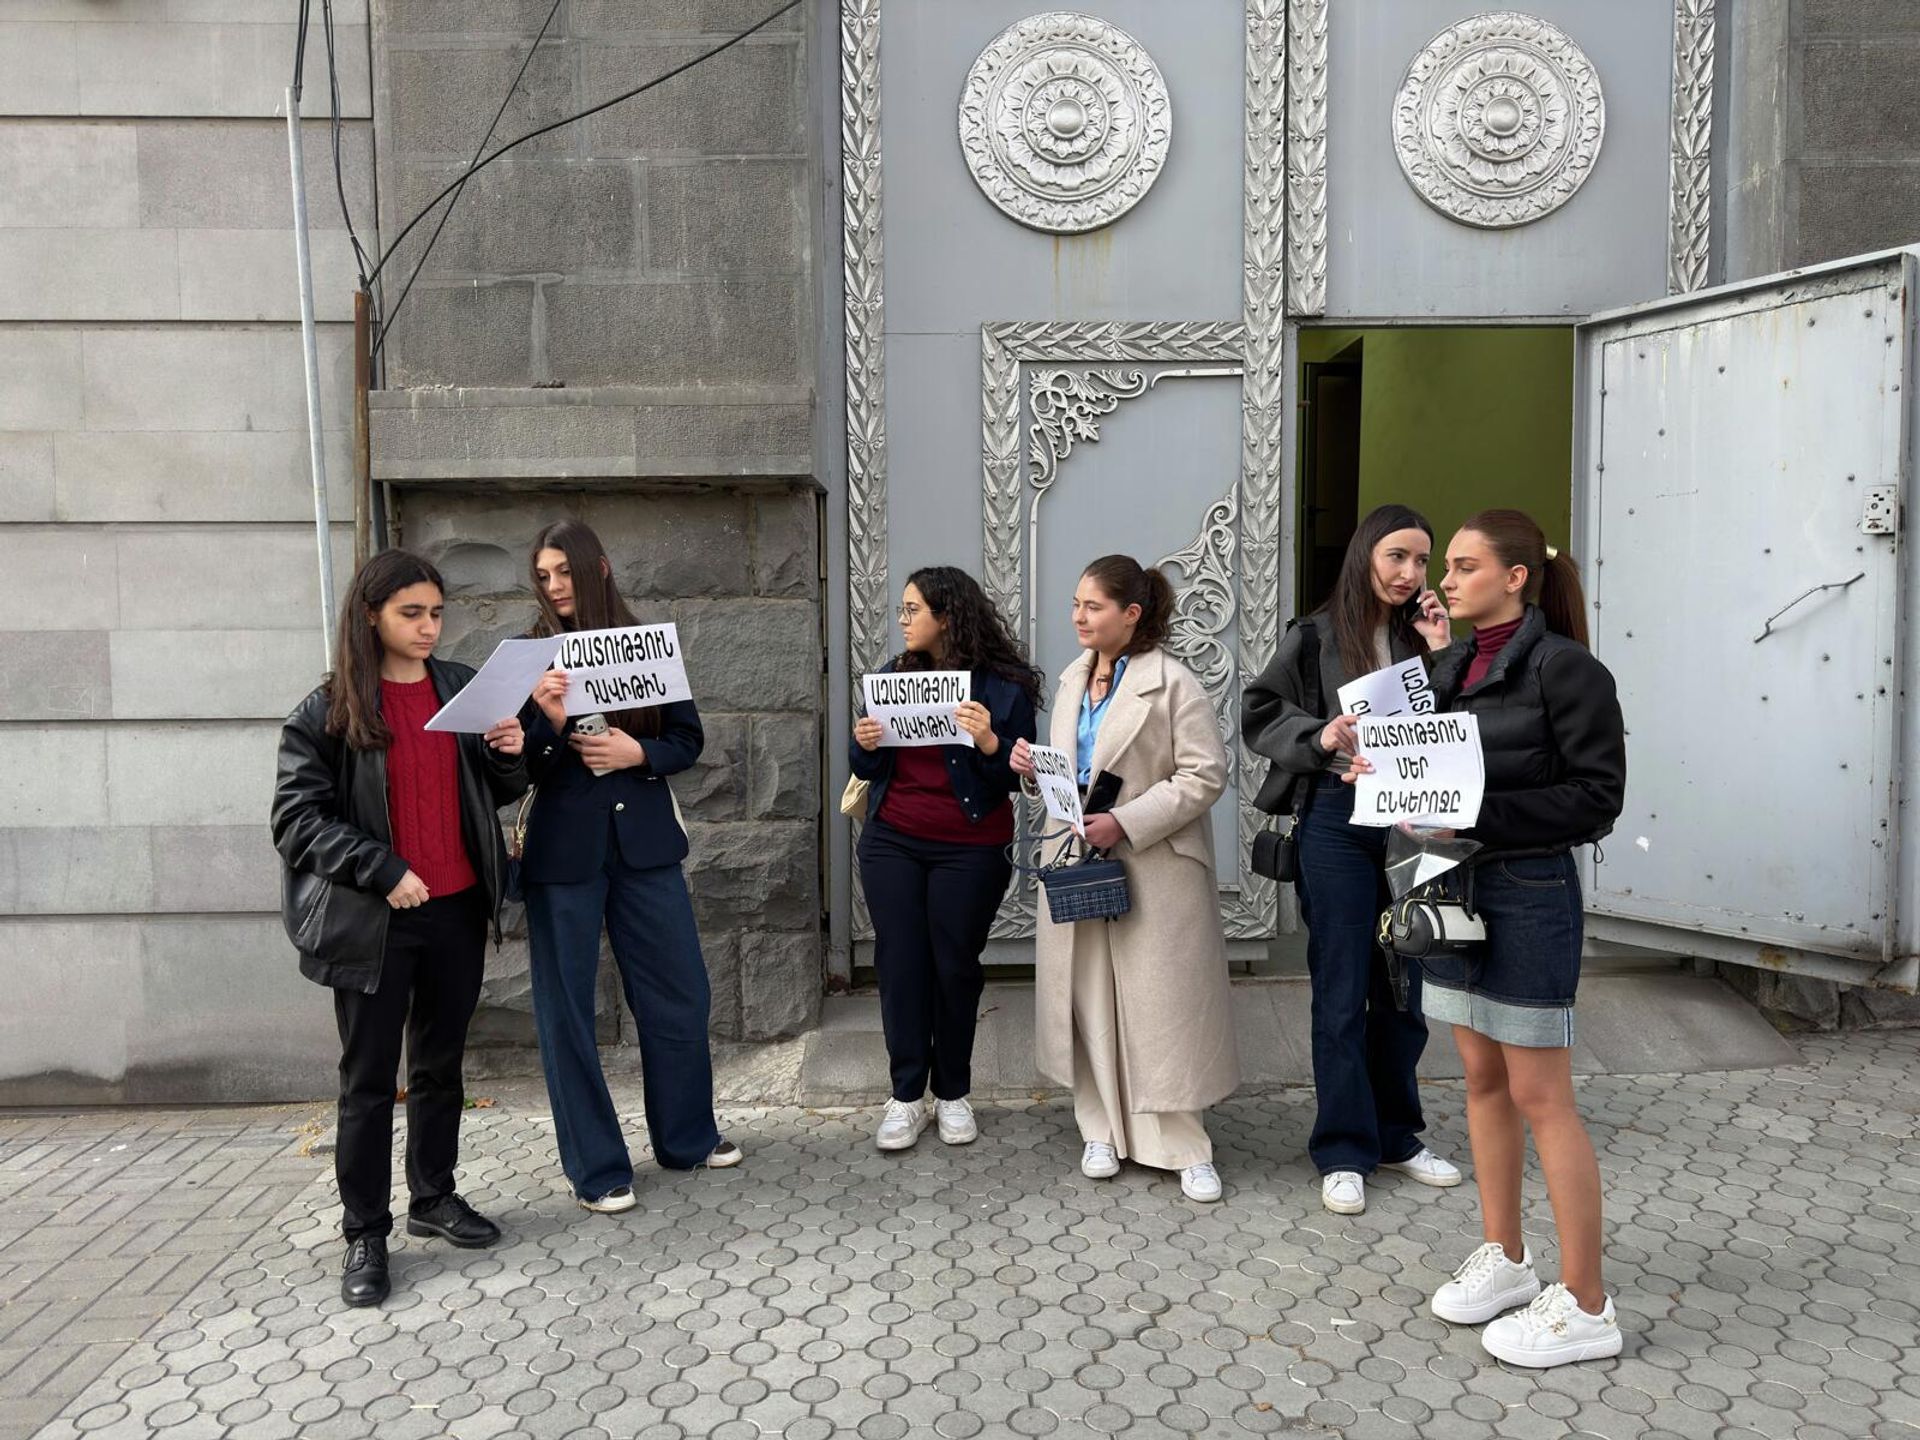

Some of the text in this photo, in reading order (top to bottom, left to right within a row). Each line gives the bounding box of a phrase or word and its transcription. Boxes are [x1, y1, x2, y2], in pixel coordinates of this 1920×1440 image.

[561, 630, 674, 670] ԱԶԱՏՈՒԹՅՈՒՆ
[585, 673, 666, 705] ԴԱՎԻԹԻՆ
[871, 676, 965, 706] ԱԶԱՏՈՒԹՅՈՒՆ
[890, 715, 957, 741] ԴԱՎԻԹԻՆ
[1362, 719, 1467, 749] ԱԶԱՏՈՒԹՅՈՒՆ
[1396, 756, 1429, 780] ՄԵՐ
[1376, 790, 1461, 814] ԸՆԿԵՐՈՋԸ
